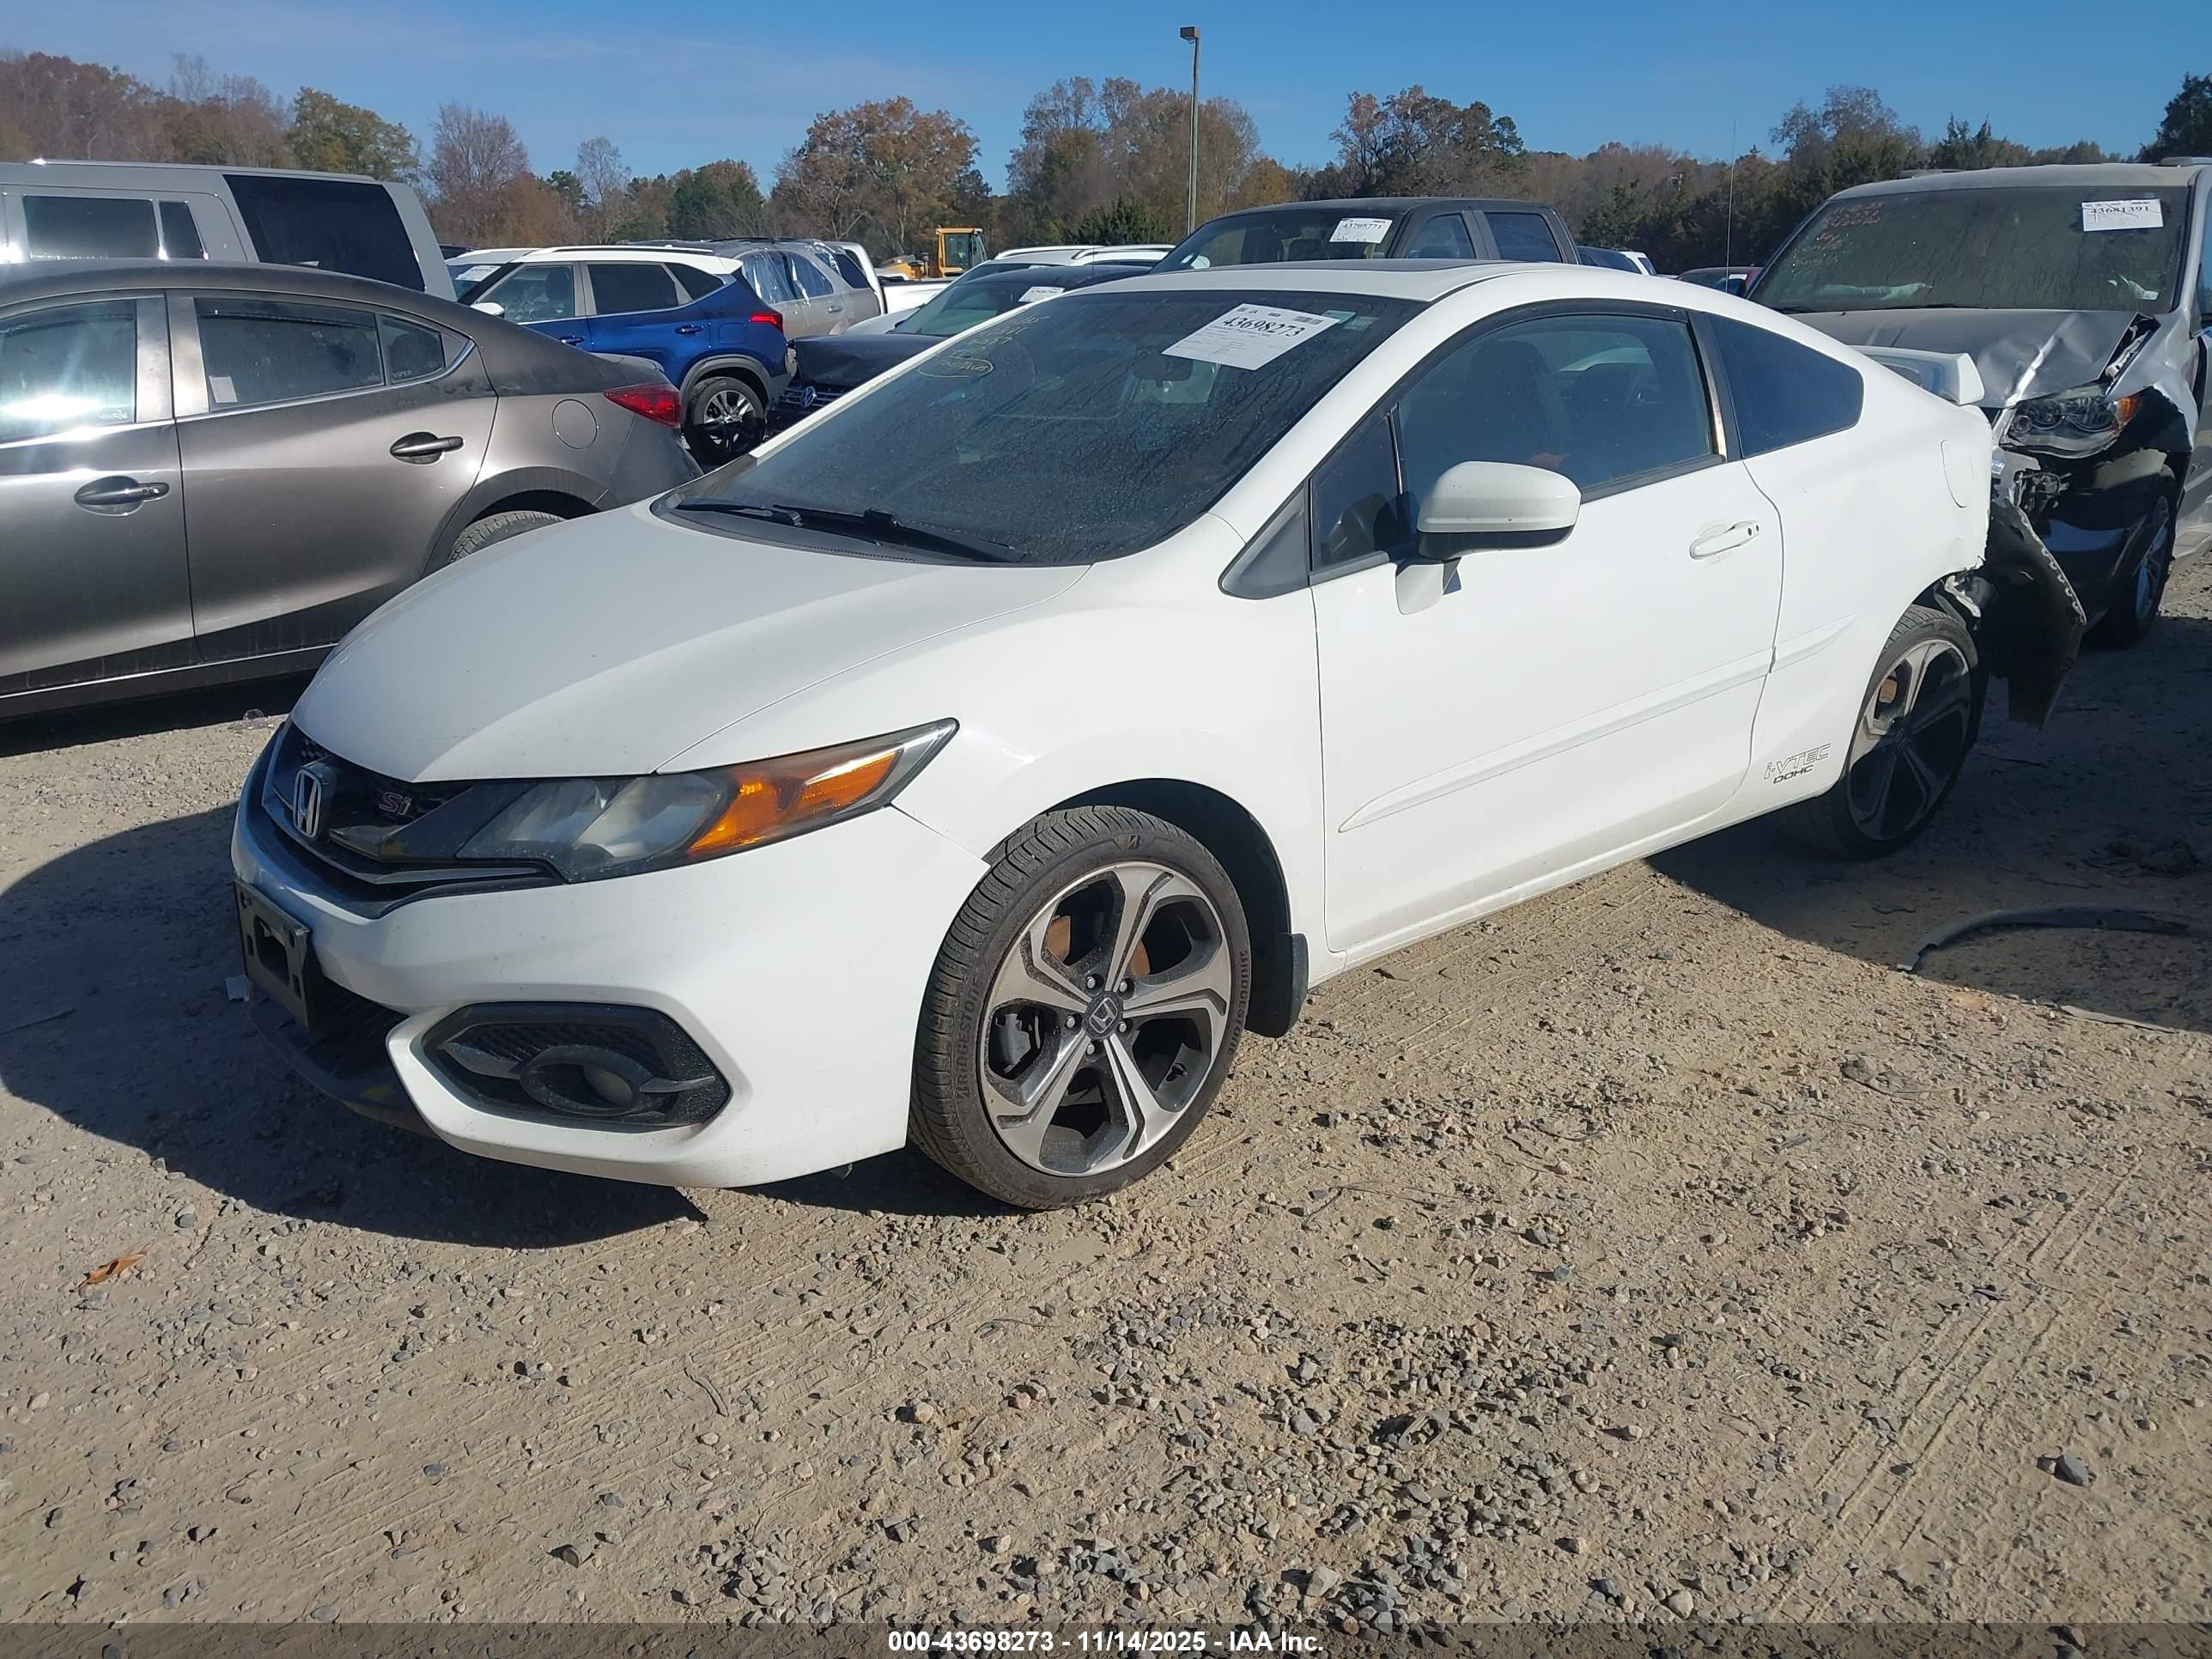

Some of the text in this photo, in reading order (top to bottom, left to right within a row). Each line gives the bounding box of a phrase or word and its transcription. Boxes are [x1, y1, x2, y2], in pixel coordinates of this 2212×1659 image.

[1223, 317, 1306, 337] 43698273
[1773, 764, 1814, 784] DOHC
[379, 792, 412, 815] Si
[1228, 950, 1249, 1054] BRIDGESTONE
[956, 974, 982, 1100] BRIDGESTONE
